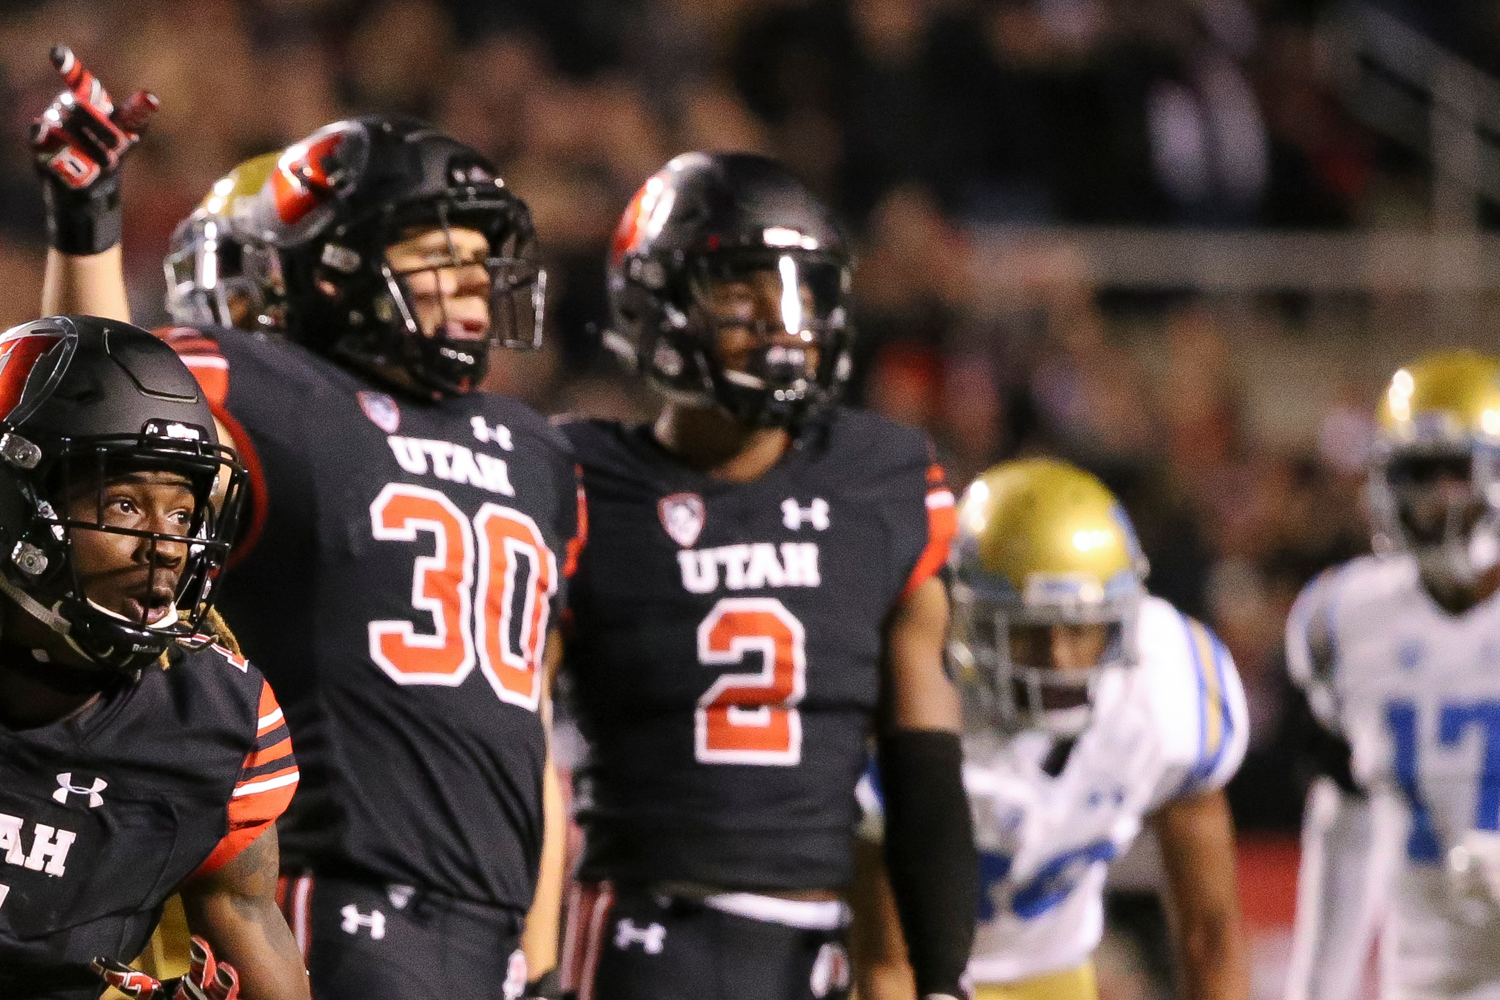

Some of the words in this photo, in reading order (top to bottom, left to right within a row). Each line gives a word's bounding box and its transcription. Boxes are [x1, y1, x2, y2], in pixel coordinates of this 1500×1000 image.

[387, 435, 516, 498] UTAH
[369, 482, 558, 712] 30
[677, 542, 821, 594] UTAH
[694, 597, 806, 766] 2
